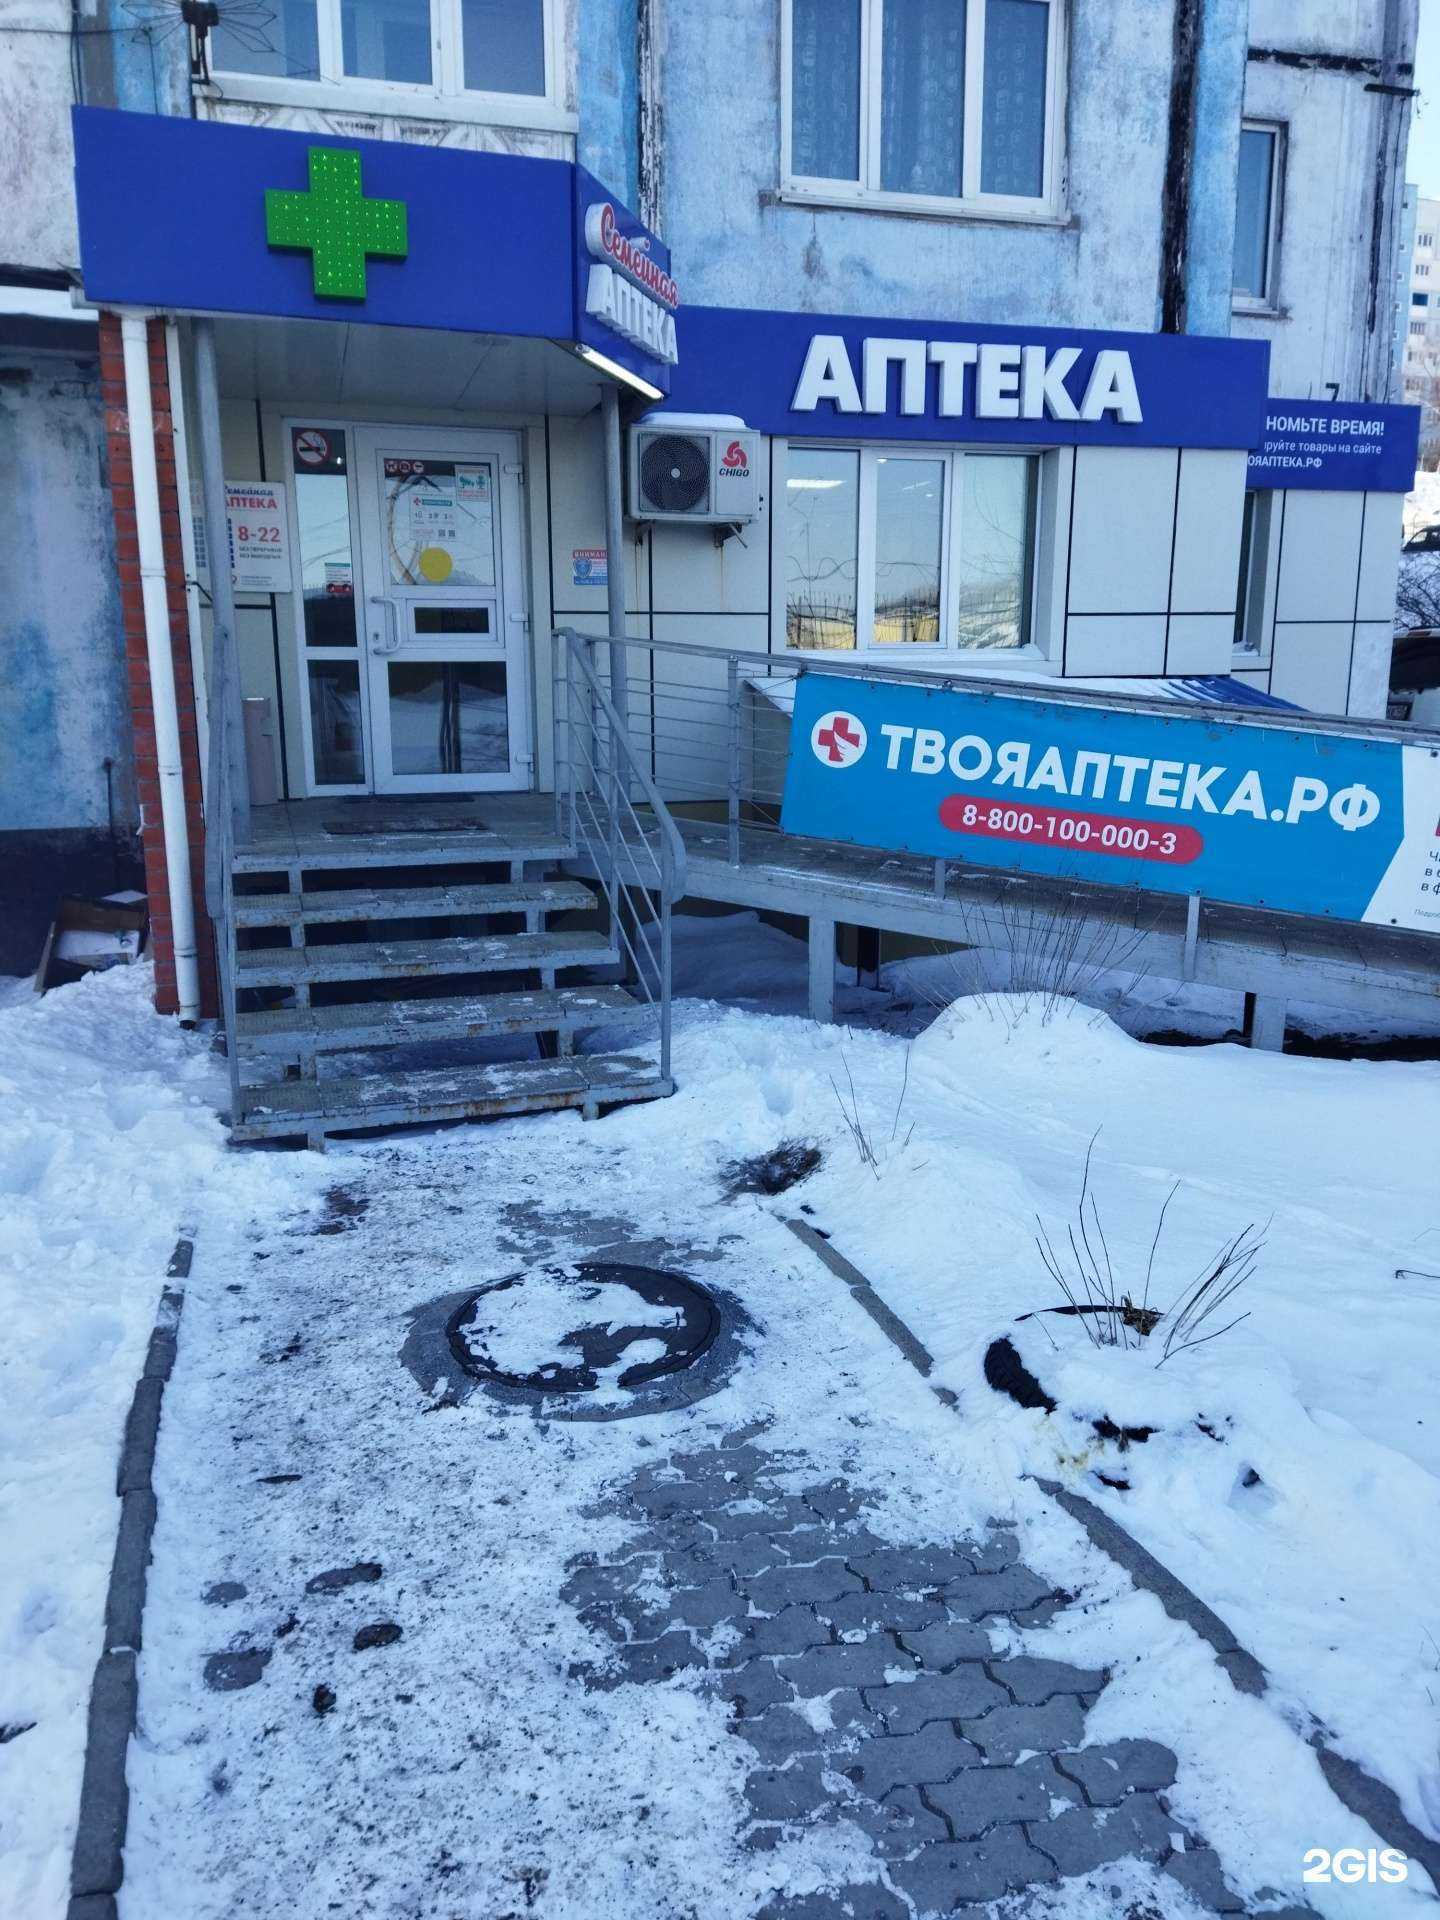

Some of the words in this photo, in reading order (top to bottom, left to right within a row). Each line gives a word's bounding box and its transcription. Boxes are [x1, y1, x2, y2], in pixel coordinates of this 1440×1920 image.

[596, 203, 679, 309] Семейная
[588, 264, 679, 365] АПТЕКА
[790, 334, 1144, 424] АПТЕКА
[1299, 442, 1337, 454] товары
[1338, 444, 1351, 453] на
[1353, 443, 1382, 454] сайте
[1331, 419, 1385, 436] ВРЕМЯ!
[719, 468, 750, 477] CHIGO
[238, 526, 281, 543] 8-22
[881, 724, 1381, 832] ТВОЯАПТЕКА.РФ
[962, 804, 1177, 855] 8-800-100-000-3
